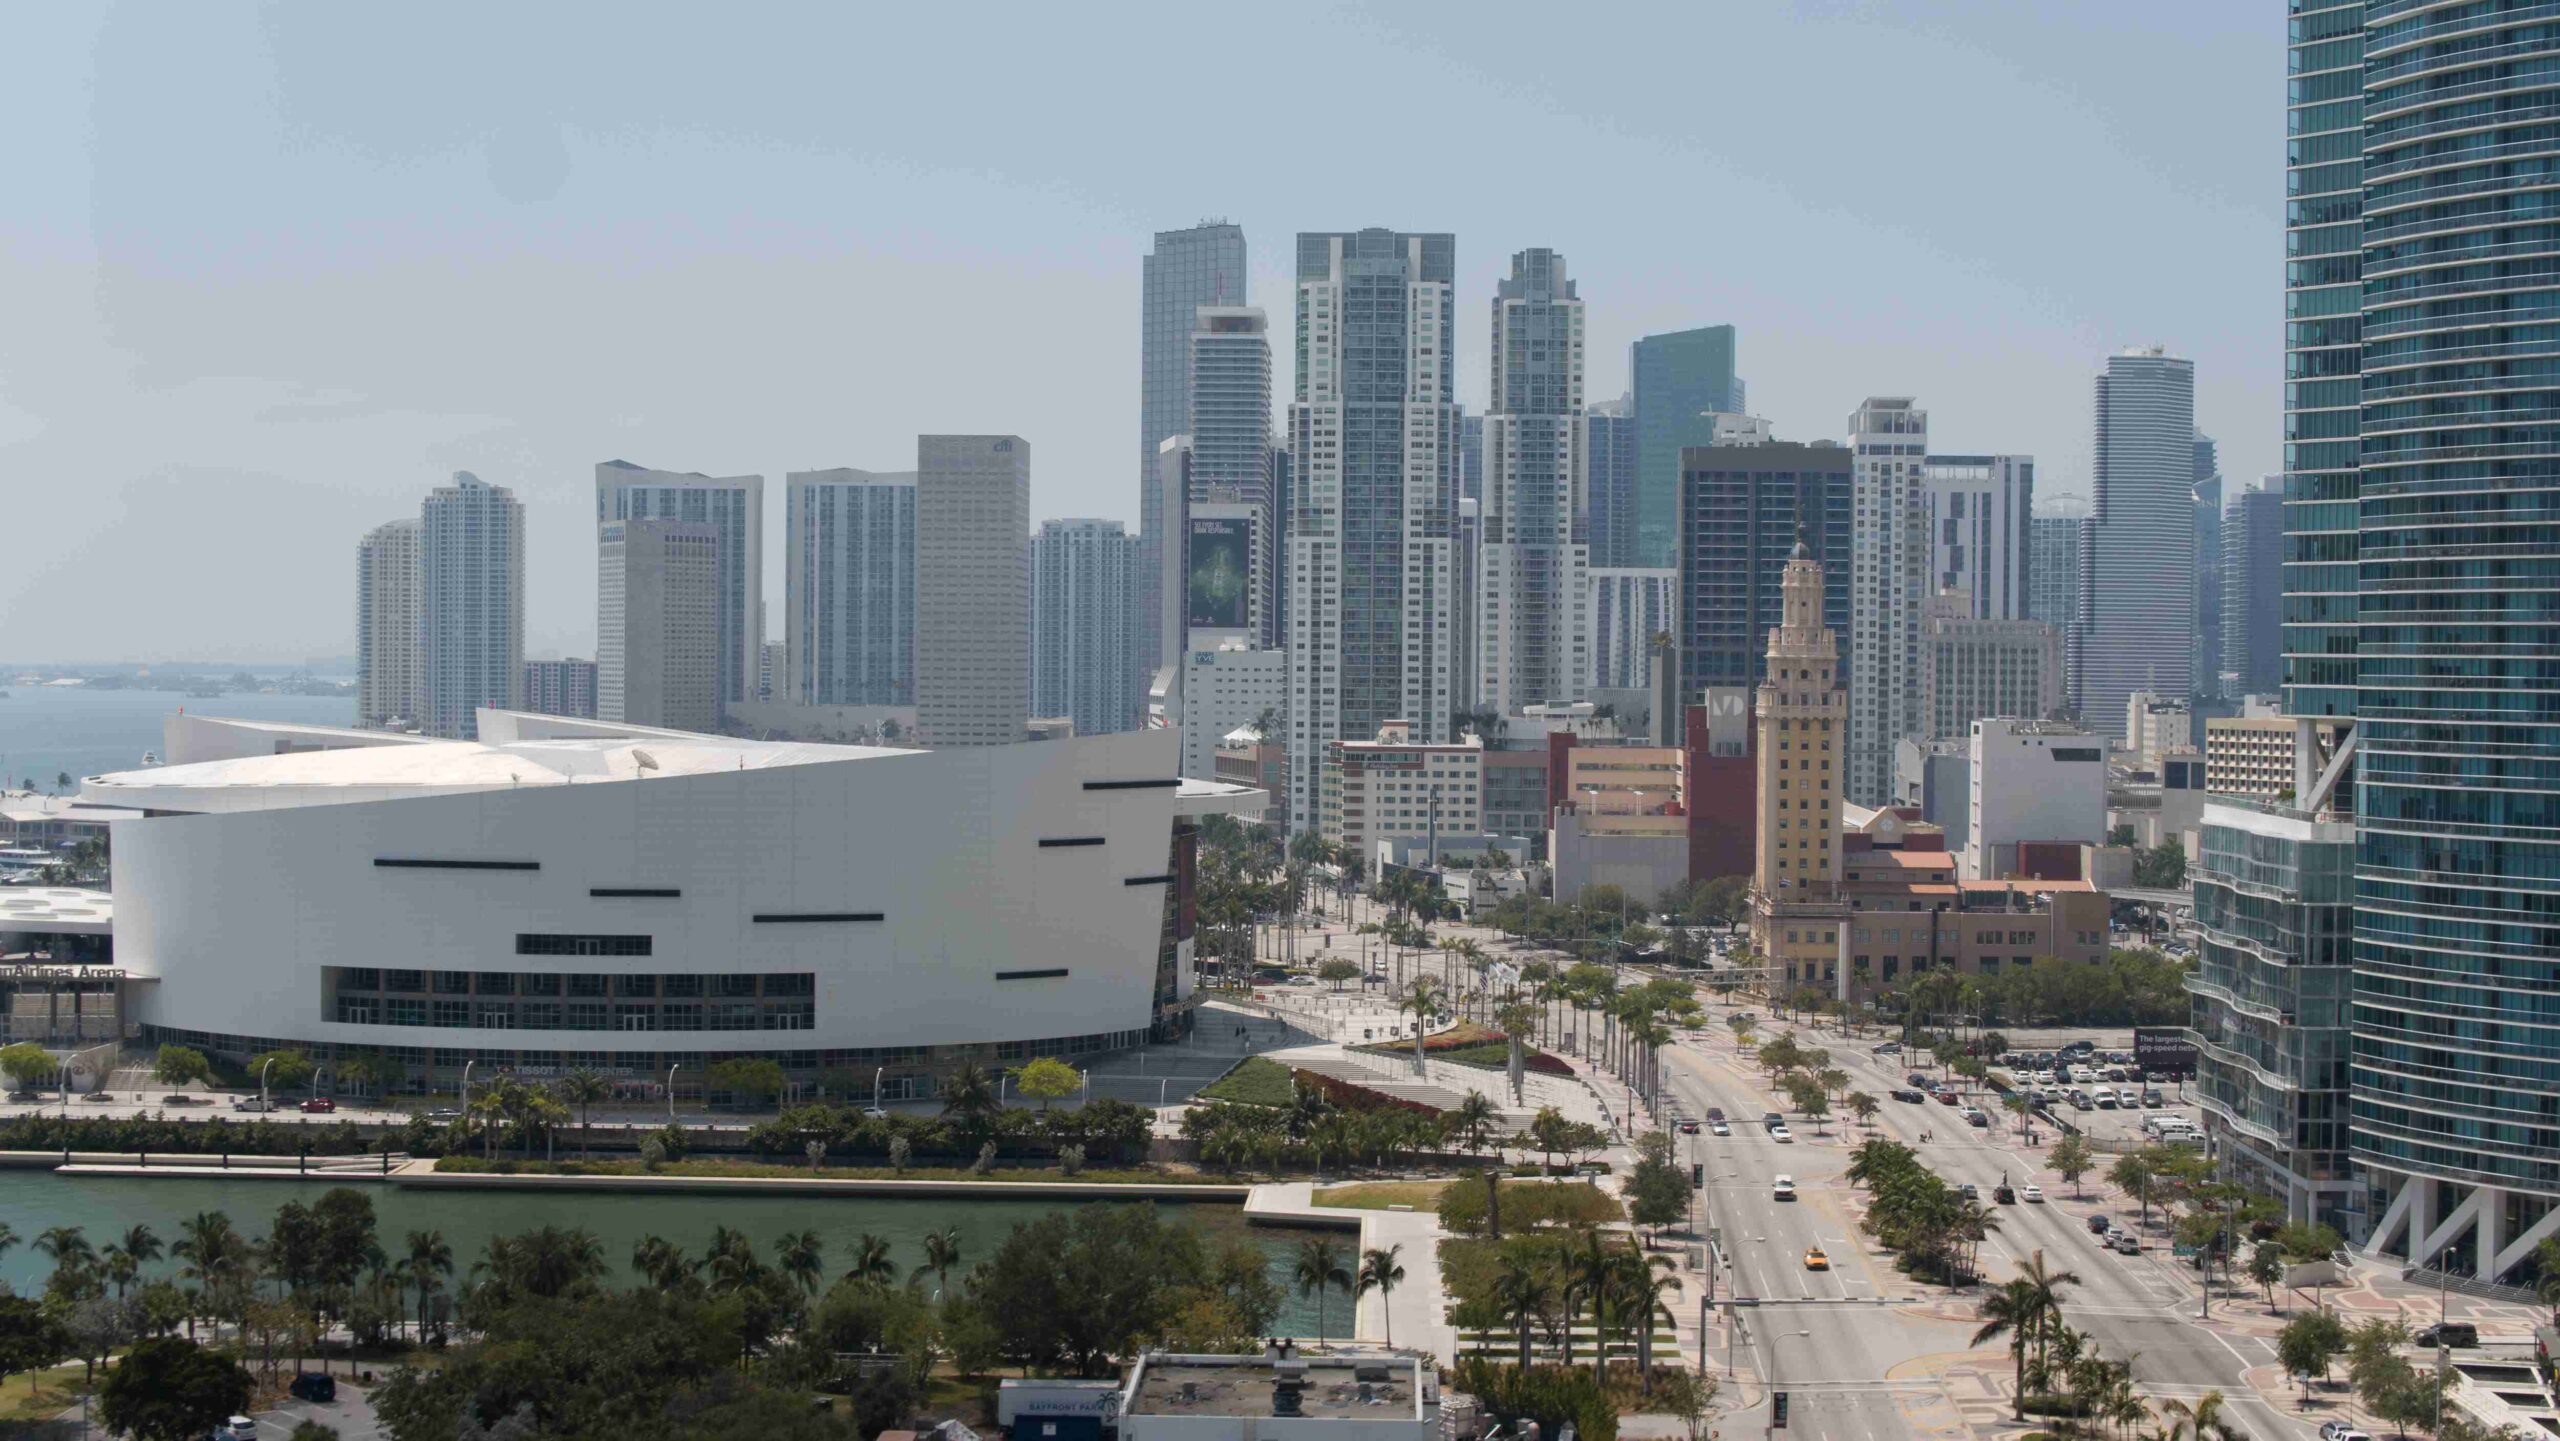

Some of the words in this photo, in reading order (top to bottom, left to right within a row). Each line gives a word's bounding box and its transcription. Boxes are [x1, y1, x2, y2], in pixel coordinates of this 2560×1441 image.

[80, 966, 126, 978] Arena
[2139, 1035, 2153, 1043] The
[2155, 1035, 2181, 1044] largest
[2139, 1044, 2177, 1053] gig-speed
[514, 1066, 556, 1075] TISSOT
